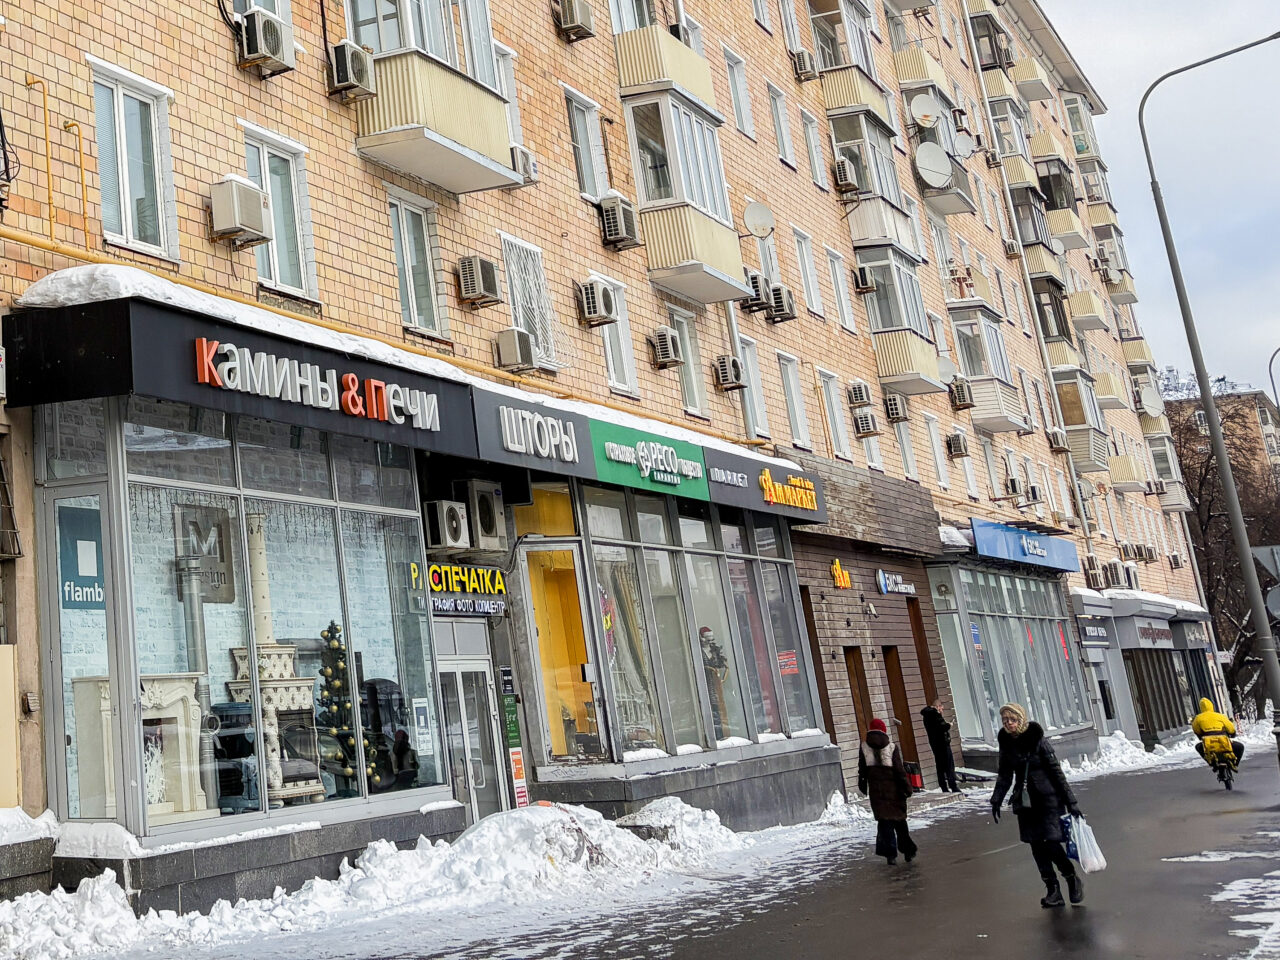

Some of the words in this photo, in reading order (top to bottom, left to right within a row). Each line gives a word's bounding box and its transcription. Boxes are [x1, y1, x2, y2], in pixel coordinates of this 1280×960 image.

[341, 372, 365, 417] &
[499, 405, 580, 464] ШТОРЫ
[63, 581, 105, 603] flamb
[456, 599, 474, 613] ФОТО
